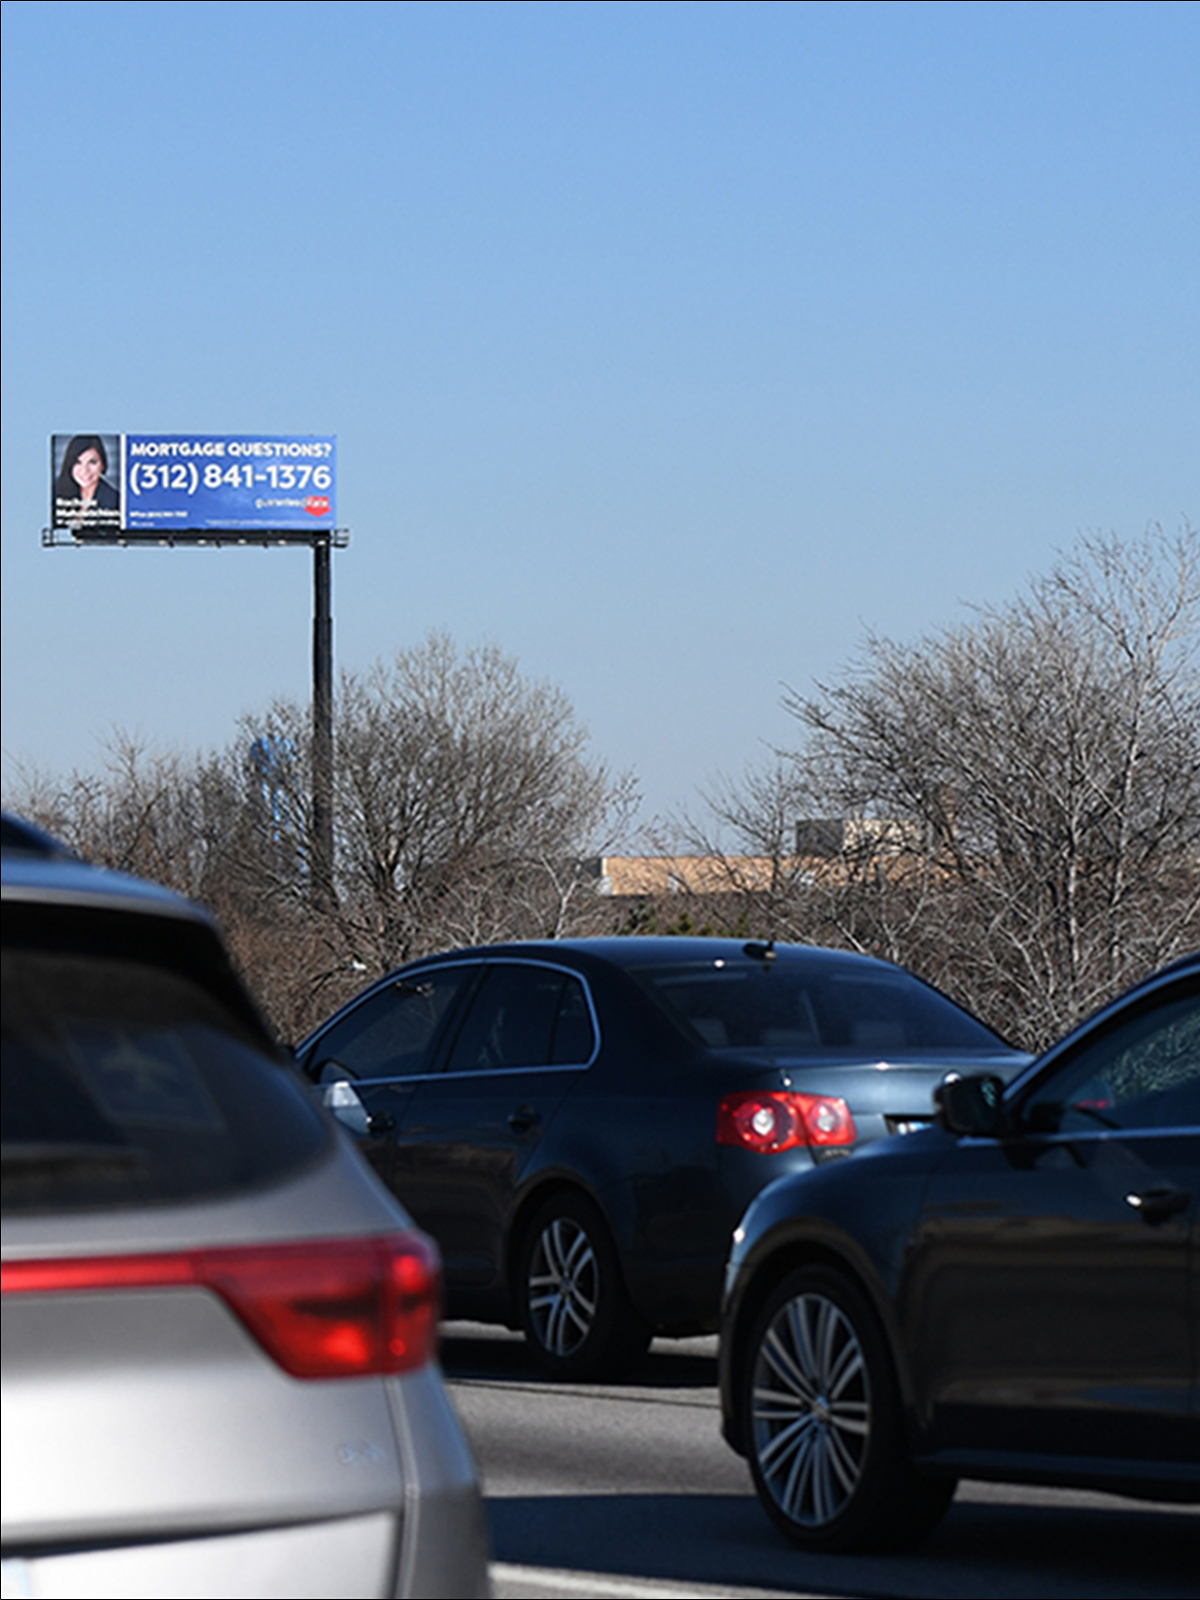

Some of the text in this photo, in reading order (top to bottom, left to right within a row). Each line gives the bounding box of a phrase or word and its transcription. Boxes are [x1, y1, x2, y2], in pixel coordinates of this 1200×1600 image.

[130, 442, 332, 458] MORTGAGE QUESTIONS?
[129, 462, 332, 496] (312) 841-1376
